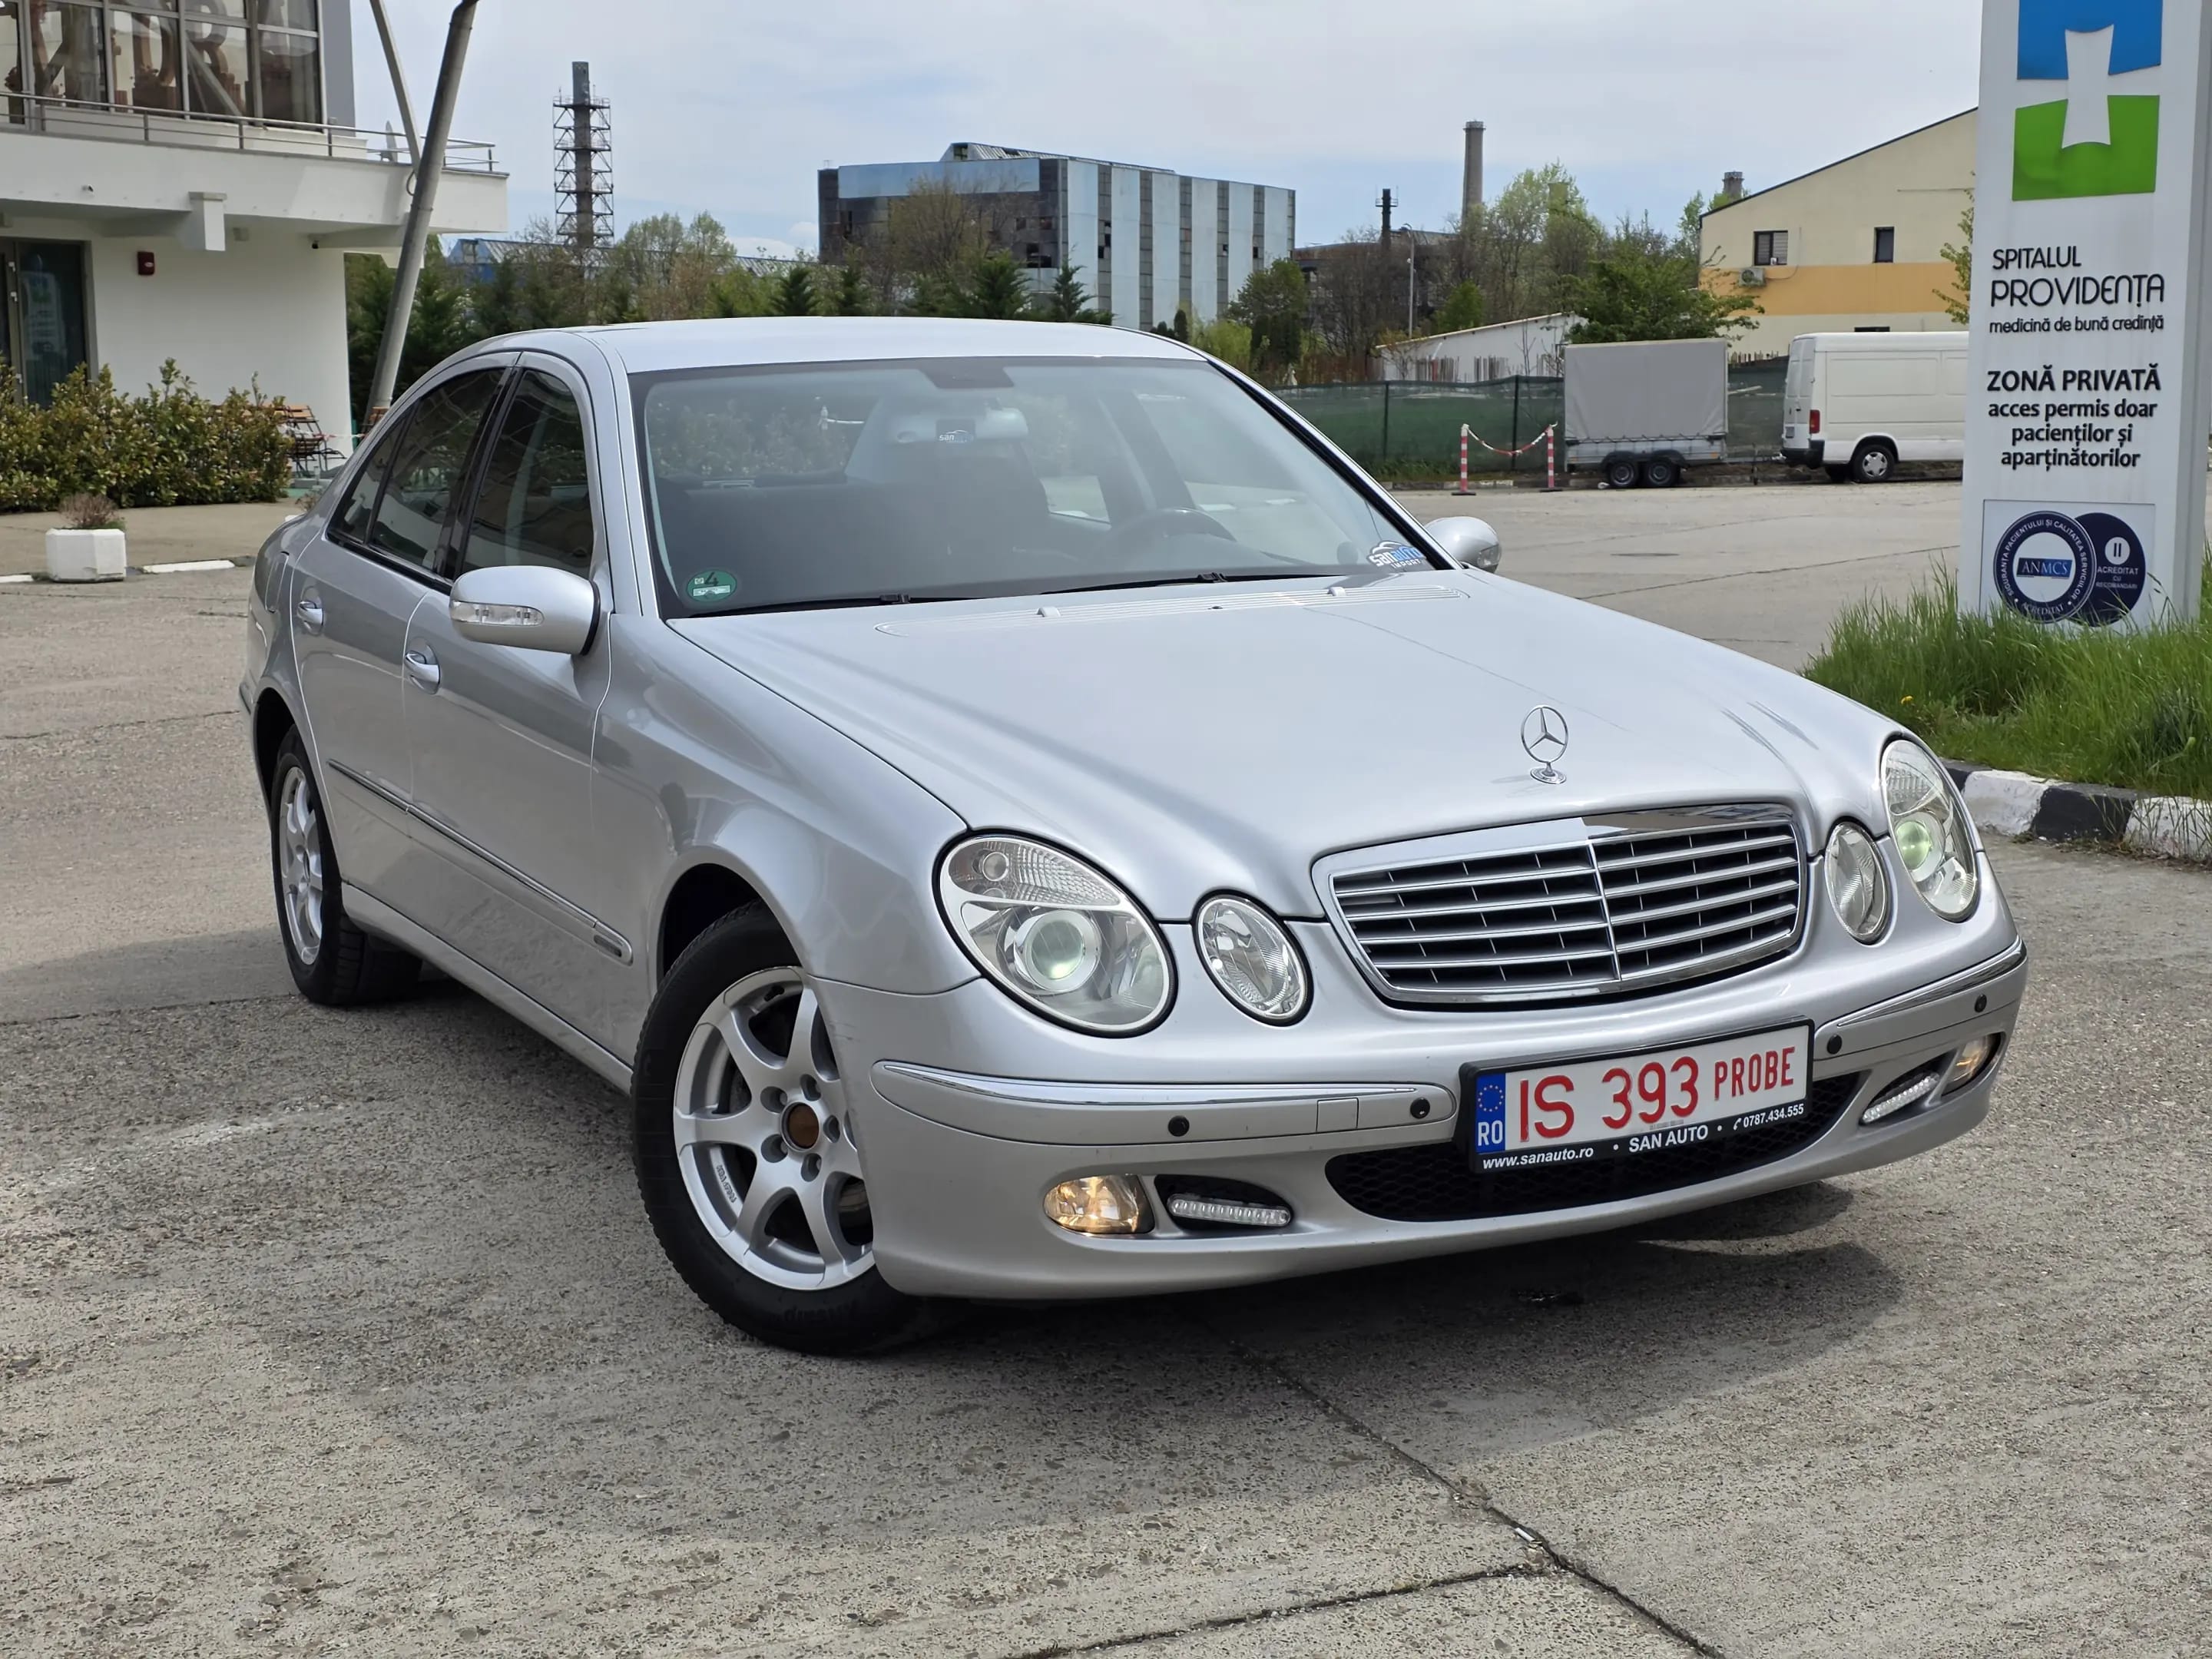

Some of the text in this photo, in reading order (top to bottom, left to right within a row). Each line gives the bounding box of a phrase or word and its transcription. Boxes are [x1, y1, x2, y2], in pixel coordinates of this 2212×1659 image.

[1992, 246, 2082, 270] SPITALUL
[1990, 273, 2165, 308] PROVIDENȚA
[1989, 314, 2164, 333] medicină de bună credință
[1987, 363, 2161, 392] ZONĂ PRIVATĂ
[1988, 399, 2157, 421] acces permis doar
[2012, 423, 2133, 447] pacienților și
[2002, 448, 2141, 472] aparținătorilor
[2054, 521, 2084, 551] CALITATEA
[704, 571, 719, 586] 4
[2021, 561, 2068, 575] ANMCS
[2097, 566, 2138, 575] ACREDITAT
[1519, 1047, 1795, 1143] IS 393 PROBE
[1478, 1120, 1503, 1146] RO
[1483, 1147, 1594, 1169] www.sanauto.ro
[1628, 1133, 1662, 1152] SAN
[1665, 1124, 1709, 1146] AUTO
[1743, 1103, 1804, 1128] 0787.434.555
